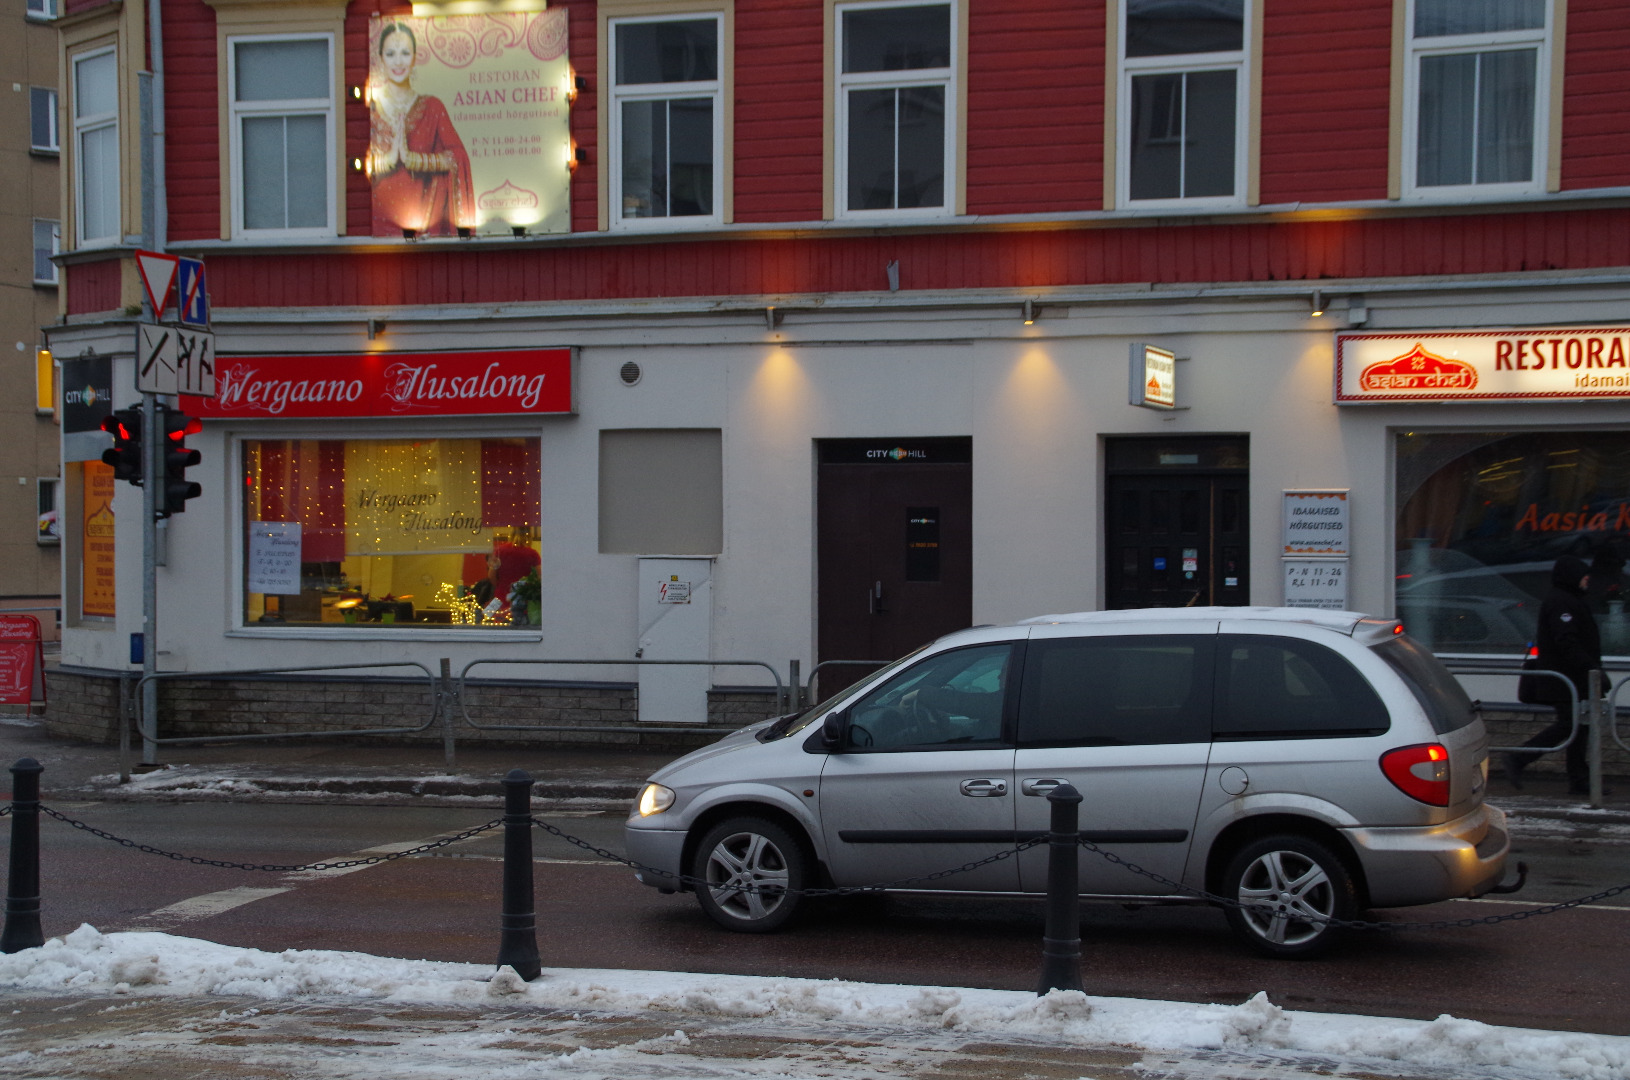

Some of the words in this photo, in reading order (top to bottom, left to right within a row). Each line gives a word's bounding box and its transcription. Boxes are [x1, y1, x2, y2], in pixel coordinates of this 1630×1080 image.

[469, 69, 540, 84] RESTORAN
[453, 88, 506, 106] ASIAN
[512, 86, 558, 103] CHEF
[1495, 337, 1630, 371] RESTORA
[1368, 368, 1418, 388] asian
[1423, 366, 1469, 388] chef
[65, 390, 82, 404] CITY
[217, 364, 363, 414] Wergaano
[866, 450, 888, 458] CITY
[908, 450, 927, 458] HILL
[359, 488, 437, 513] Wergaano
[1292, 507, 1340, 516] IDAMAISED
[1515, 503, 1608, 532] Aasia
